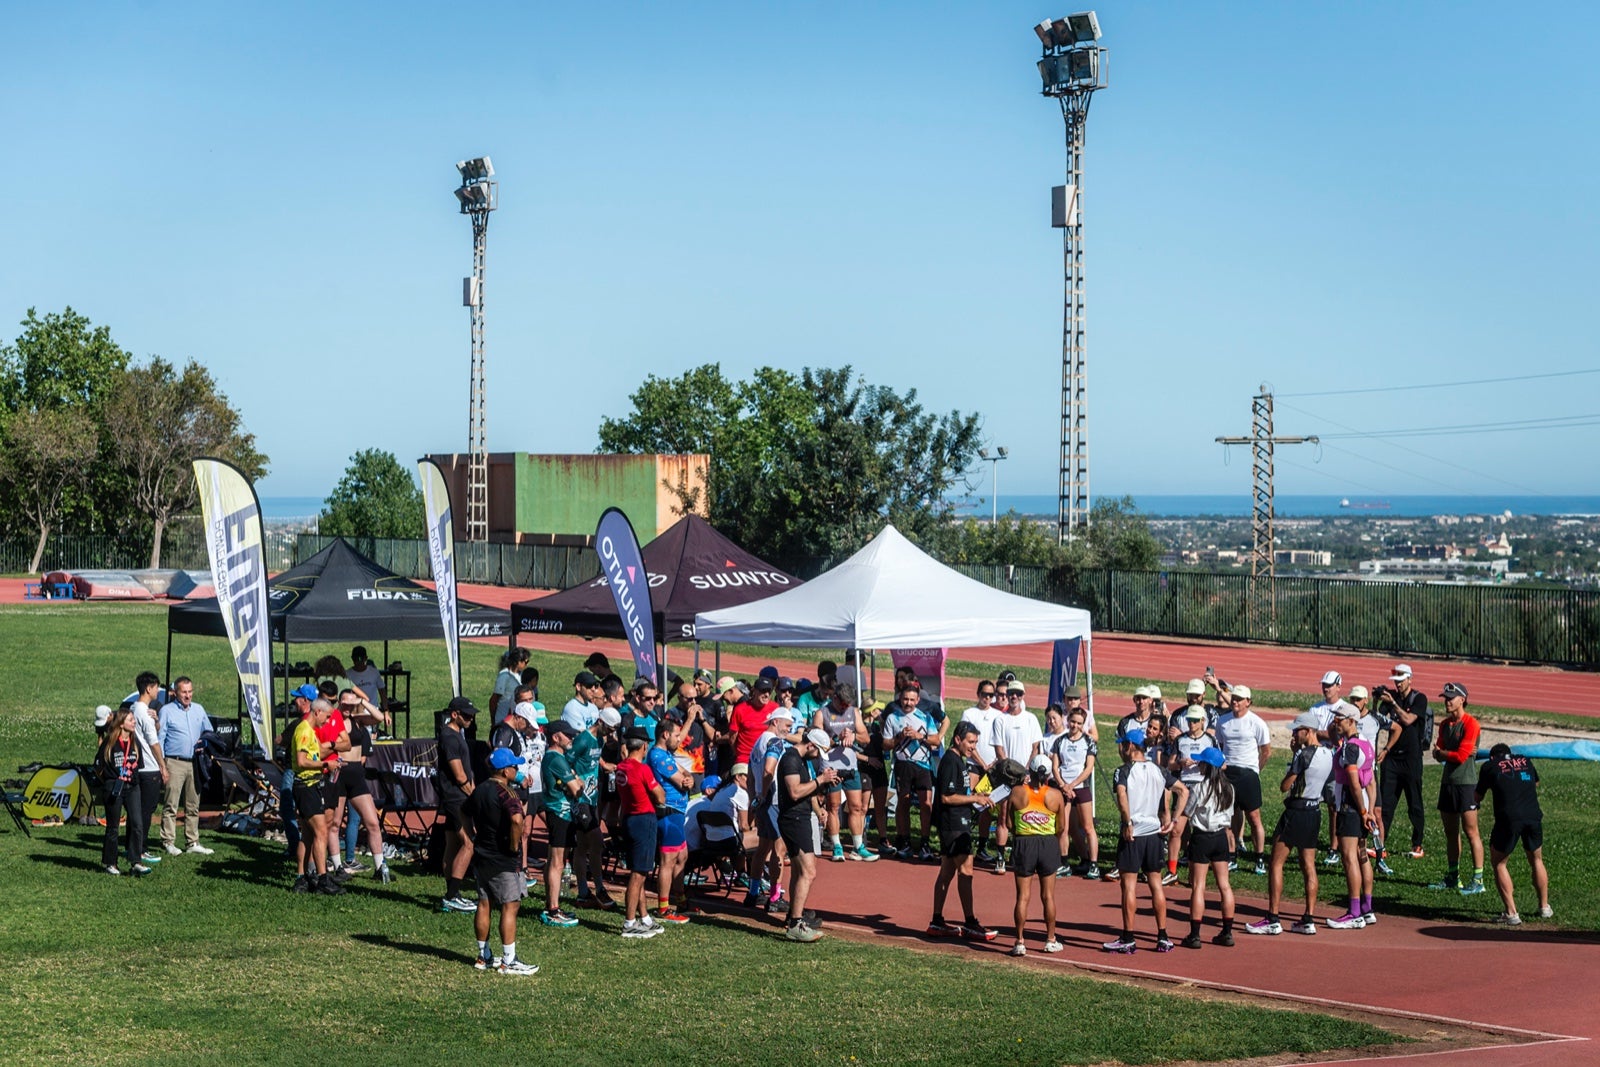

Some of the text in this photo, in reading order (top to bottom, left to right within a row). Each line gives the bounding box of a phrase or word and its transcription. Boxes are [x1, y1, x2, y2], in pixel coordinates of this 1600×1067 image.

[689, 571, 790, 589] SUUNTO
[108, 588, 131, 597] DIMA
[347, 590, 409, 600] FUGA
[459, 623, 490, 637] UGA
[896, 647, 940, 657] Glucobar
[1498, 757, 1527, 769] STAFF
[393, 764, 427, 779] FUGA
[29, 790, 62, 809] FUGA
